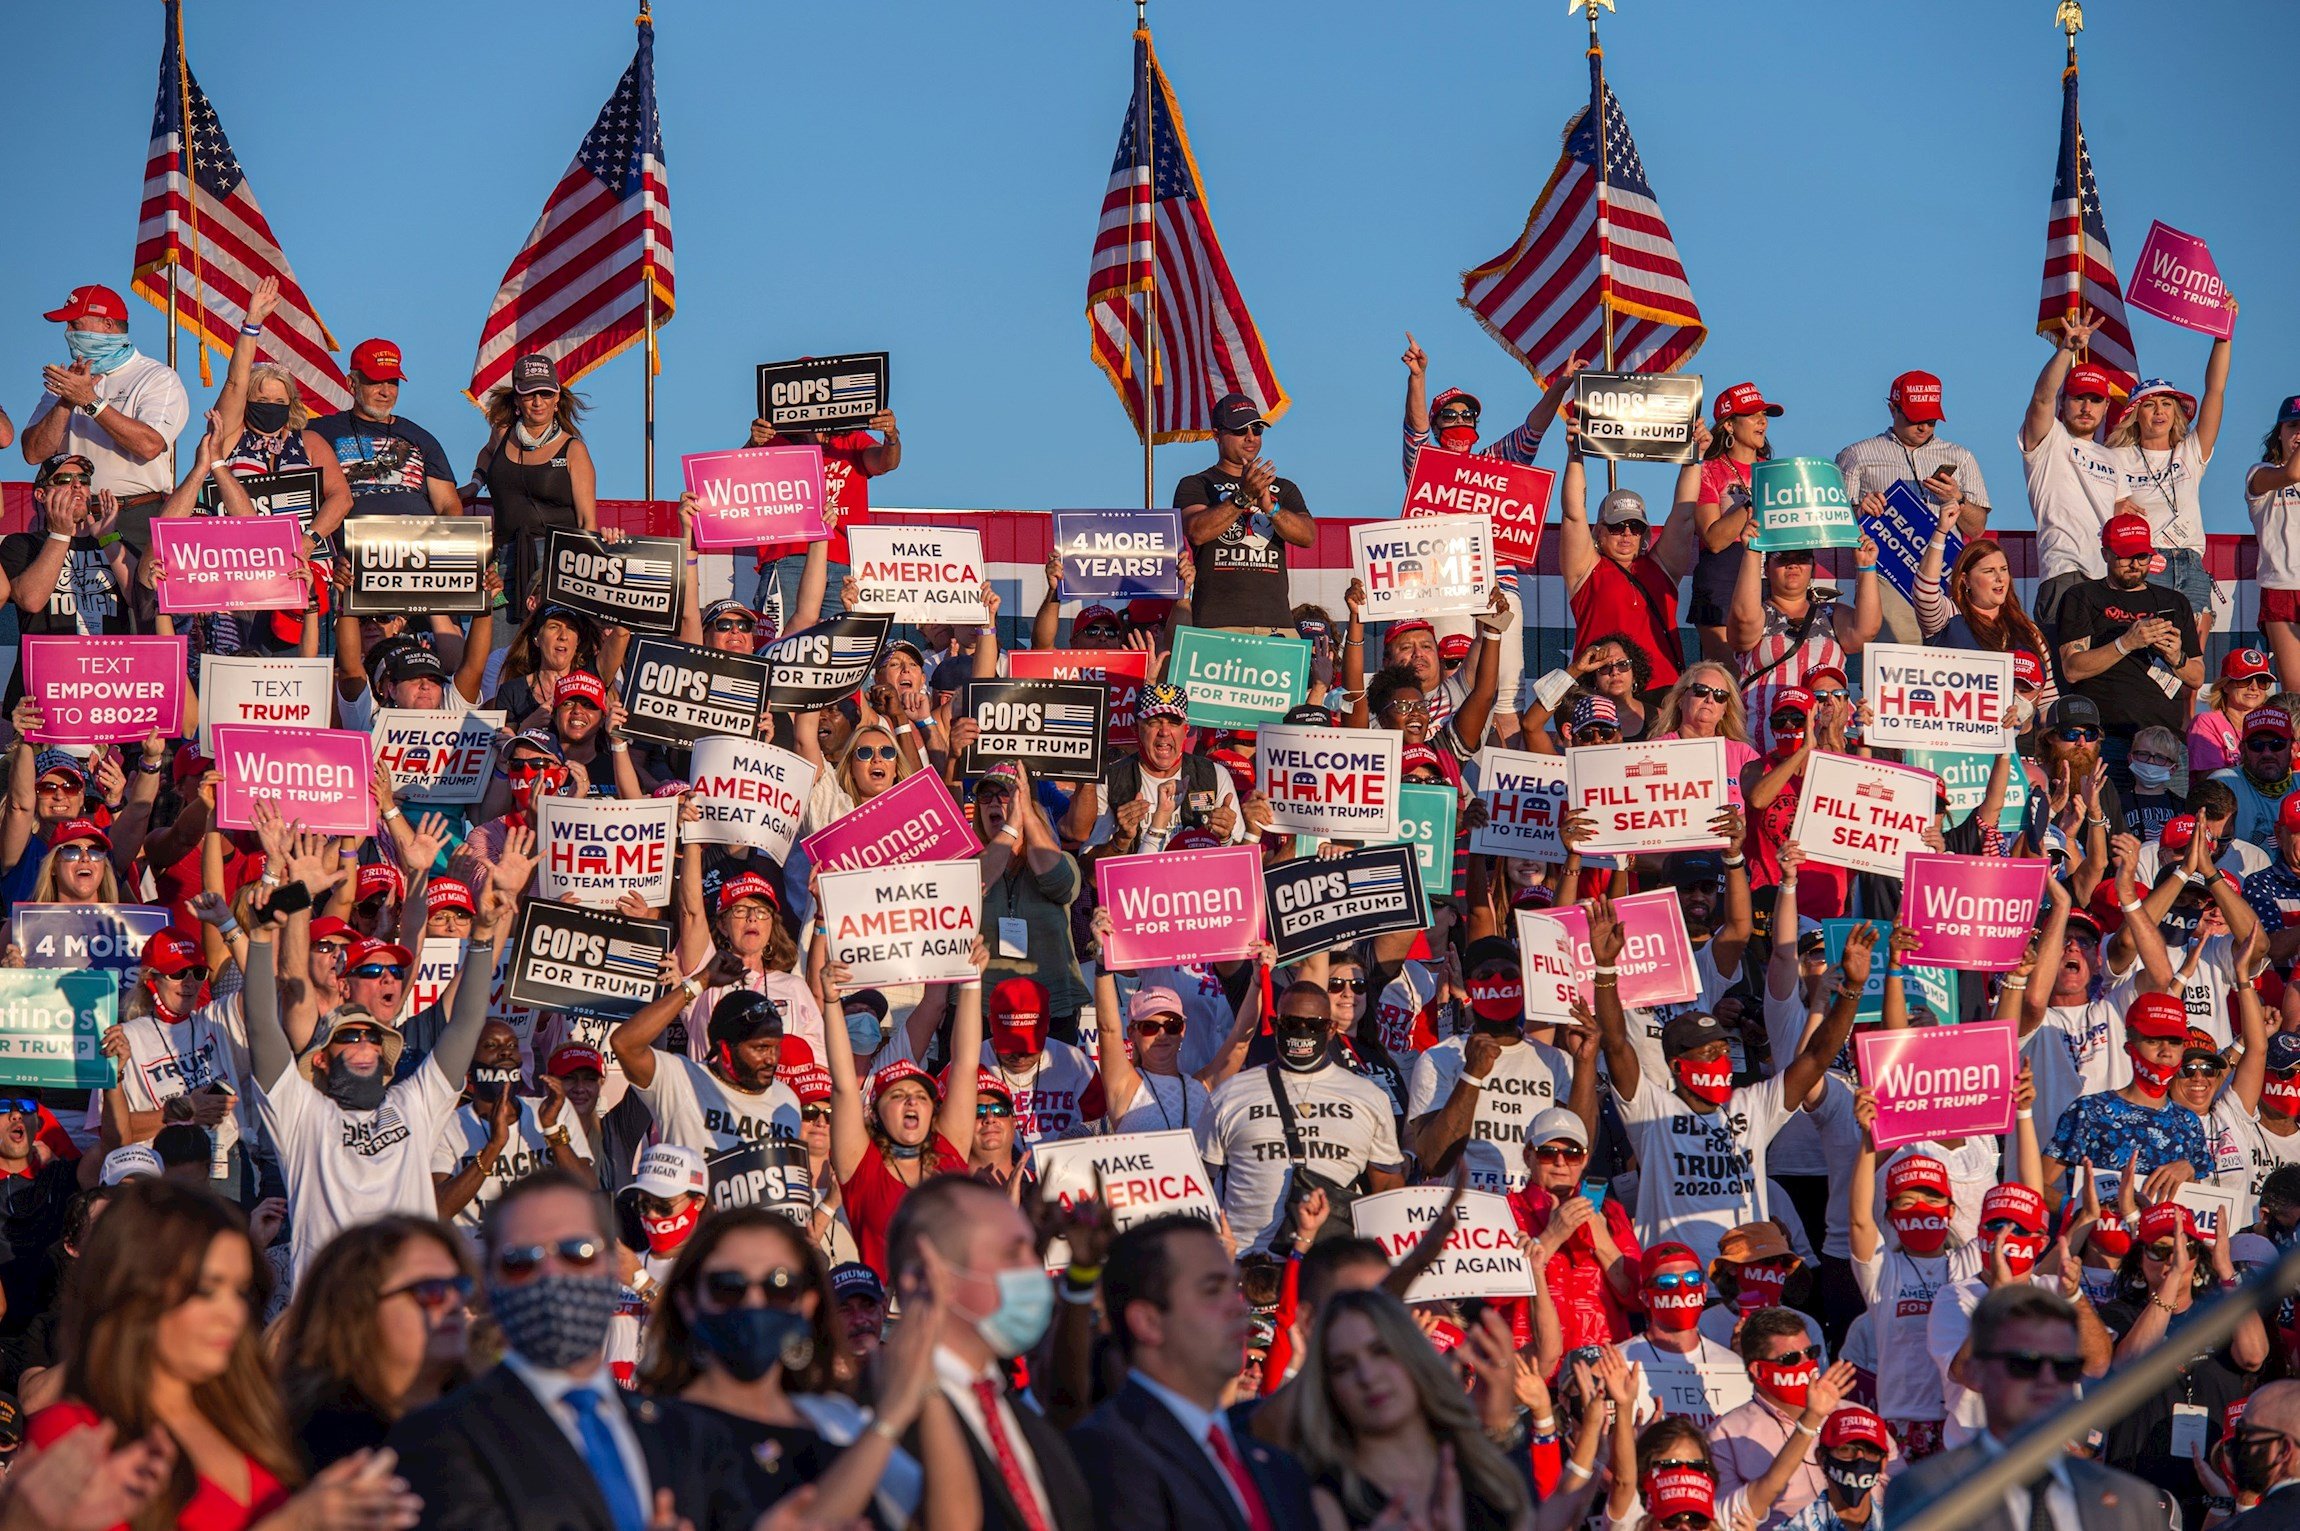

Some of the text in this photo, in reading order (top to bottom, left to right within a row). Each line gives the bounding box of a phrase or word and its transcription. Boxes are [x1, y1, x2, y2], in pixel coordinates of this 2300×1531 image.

[2153, 279, 2221, 309] FOR TRUMP
[771, 378, 831, 407] COPS
[776, 401, 874, 421] FOR TRUMP
[1588, 391, 1646, 418] COPS
[1591, 423, 1686, 439] FOR TRUMP
[1454, 467, 1509, 492] MAKE
[703, 478, 812, 507] Women
[720, 502, 804, 520] FOR TRUMP
[1413, 482, 1537, 526] AMERICA
[1769, 510, 1850, 525] FOR TRUMP
[891, 542, 942, 557] MAKE
[1072, 532, 1165, 551] 4 MORE
[1366, 537, 1481, 561] WELCOME
[171, 542, 285, 569] Women
[361, 539, 427, 570] COPS
[1215, 549, 1279, 563] PUMP
[188, 569, 277, 584] FOR TRUMP
[558, 549, 623, 585] COPS
[860, 562, 979, 584] AMERICA
[1075, 558, 1163, 578] YEARS!
[365, 575, 474, 589] FOR TRUMP
[561, 578, 667, 613] FOR TRUMP
[859, 589, 981, 604] GREAT AGAIN
[1373, 584, 1484, 602] TO TEAM TRUMP!
[77, 658, 135, 674] TEXT
[1053, 667, 1107, 681] MAKE
[1189, 651, 1291, 689] Latinos
[639, 661, 709, 702] COPS
[812, 668, 865, 686] TRUMP
[1879, 666, 1999, 691] WELCOME
[46, 682, 165, 699] EMPOWER
[252, 679, 302, 698] TEXT
[560, 683, 580, 694] GREAT
[1189, 686, 1286, 709] FOR TRUMP
[1780, 691, 1808, 700] Trump
[52, 706, 158, 725] TO 88022
[238, 704, 311, 721] TRUMP
[637, 698, 751, 732] FOR TRUMP
[978, 701, 1043, 732] COPS
[1881, 716, 1999, 735] TO TEAM TRUMP!
[387, 729, 490, 748] WELCOME
[981, 737, 1090, 755] FOR TRUMP
[234, 751, 354, 789] Women
[732, 755, 786, 783] MAKE
[1267, 748, 1386, 772] WELCOME
[394, 773, 478, 786] TEAM TRUMP!
[249, 787, 344, 802] FOR TRUMP
[693, 776, 801, 819] AMERICA
[1584, 780, 1714, 807] FILL THAT
[1271, 802, 1384, 819] TO TEAM TRUMP!
[1613, 808, 1688, 831] SEAT!
[1812, 795, 1862, 822] FILL
[1869, 806, 1928, 834] THAT
[551, 821, 666, 842] WELCOME
[696, 805, 795, 844] GREAT AGAIN
[1492, 823, 1554, 841] TO TEAM
[1832, 826, 1899, 856] SEAT!
[552, 874, 663, 888] TO TEAM TRUMP!
[875, 881, 939, 904] MAKE
[1275, 871, 1349, 915] COPS
[1118, 885, 1242, 922] Women
[1923, 884, 2033, 923] Women
[837, 905, 974, 941] AMERICA
[1136, 915, 1233, 935] FOR TRUMP
[1286, 896, 1403, 936] FOR TRUMP
[1935, 922, 2023, 939] FOR TRUMP
[35, 935, 56, 957] 4
[530, 924, 605, 967] COPS
[840, 938, 974, 964] GREAT AGAIN
[1176, 953, 1197, 961] 2020
[1533, 954, 1571, 978] FILL
[532, 963, 651, 998] FOR TRUMP
[1472, 984, 1522, 1000] MAGA
[20, 1039, 89, 1054] TRUMP
[1286, 1040, 1316, 1048] TRUMP
[1880, 1063, 2001, 1099] Women
[1492, 1101, 1522, 1114] FOR
[1894, 1093, 1988, 1113] FOR TRUMP
[1092, 1154, 1154, 1176] MAKE
[1674, 1149, 1753, 1180] TRUMP
[1894, 1217, 1949, 1231] MAGA
[1455, 1257, 1522, 1274] AGAIN
[832, 1269, 872, 1284] TRUMP
[1654, 1294, 1704, 1309] MAGA
[1671, 1386, 1722, 1405] TEXT
[1838, 1416, 1877, 1428] TRUMP
[1828, 1466, 1879, 1488] MAGA
